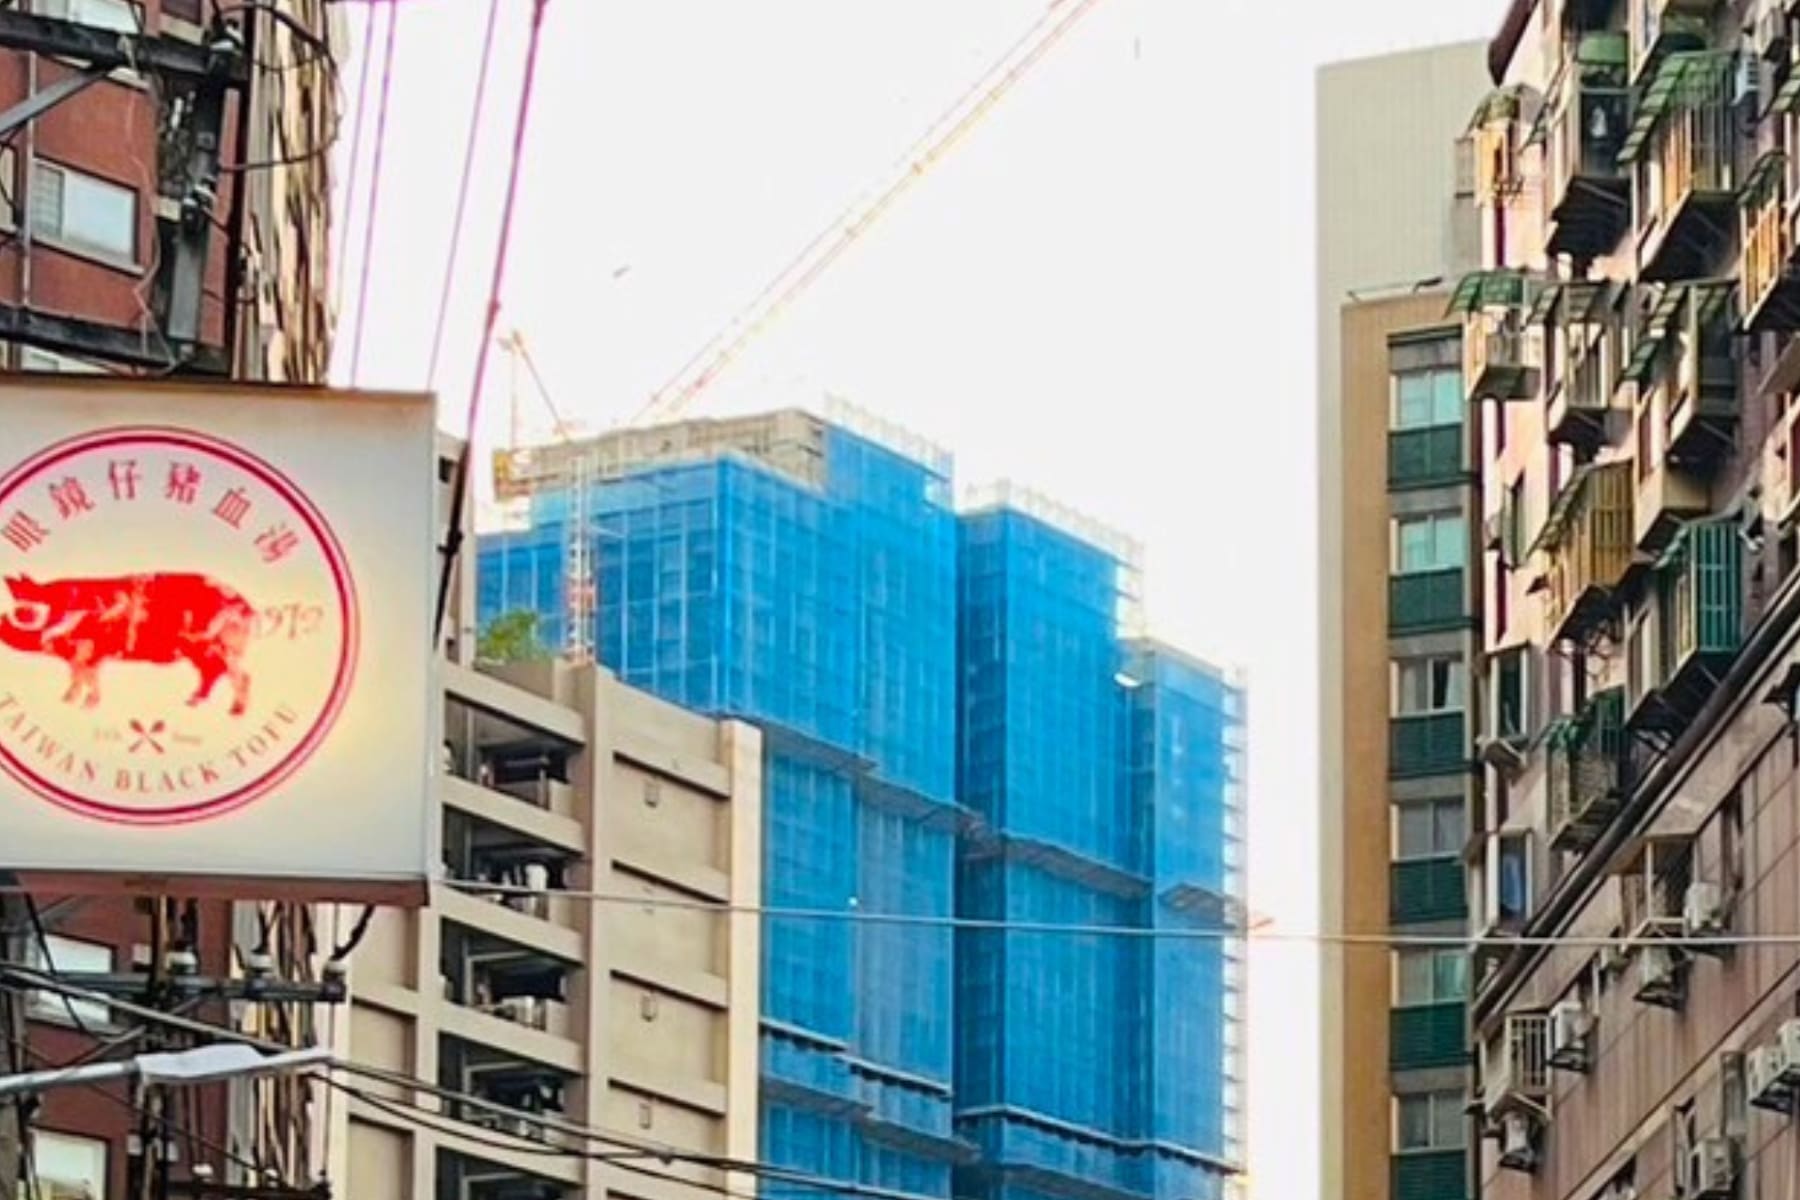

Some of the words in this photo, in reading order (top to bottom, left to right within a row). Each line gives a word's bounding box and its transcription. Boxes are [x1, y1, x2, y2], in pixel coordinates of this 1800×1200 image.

[1, 694, 97, 781] TAIWAN
[115, 760, 219, 792] BLACK
[230, 704, 297, 768] TOFU
